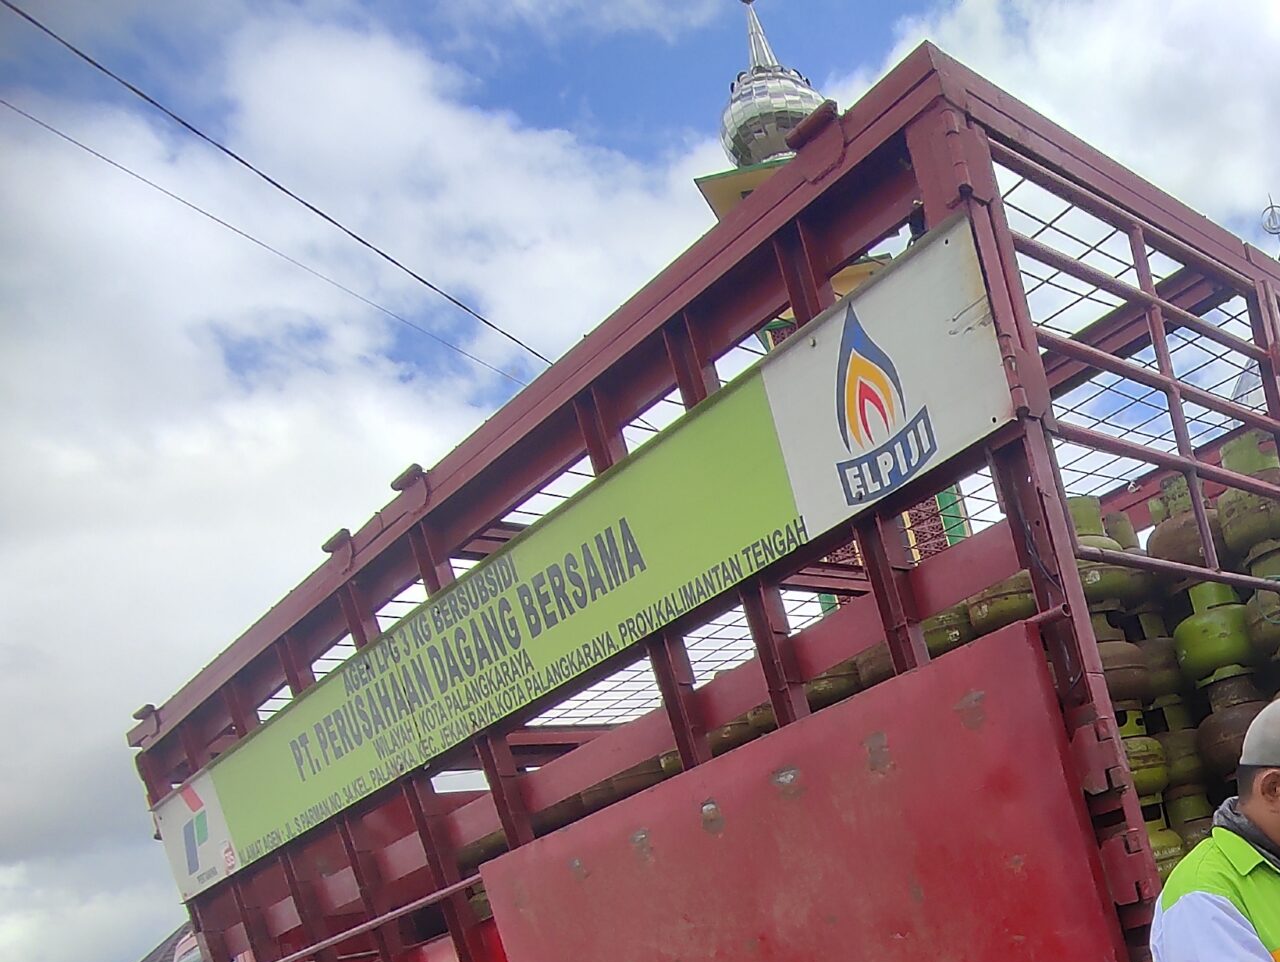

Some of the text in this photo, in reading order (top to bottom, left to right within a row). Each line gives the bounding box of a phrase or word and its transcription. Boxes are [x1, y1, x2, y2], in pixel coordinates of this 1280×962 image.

[845, 419, 931, 499] ELPIJI
[289, 517, 647, 782] PT. PERUSAHAAN DAGANG BERSAMA
[343, 553, 519, 697] AGEN LPG 3 KG BERSUBSIDI
[440, 715, 470, 748] JEKAN
[742, 515, 810, 572] TENGAH
[373, 648, 535, 760] WILAYAH KOTA PALANGKARAYA
